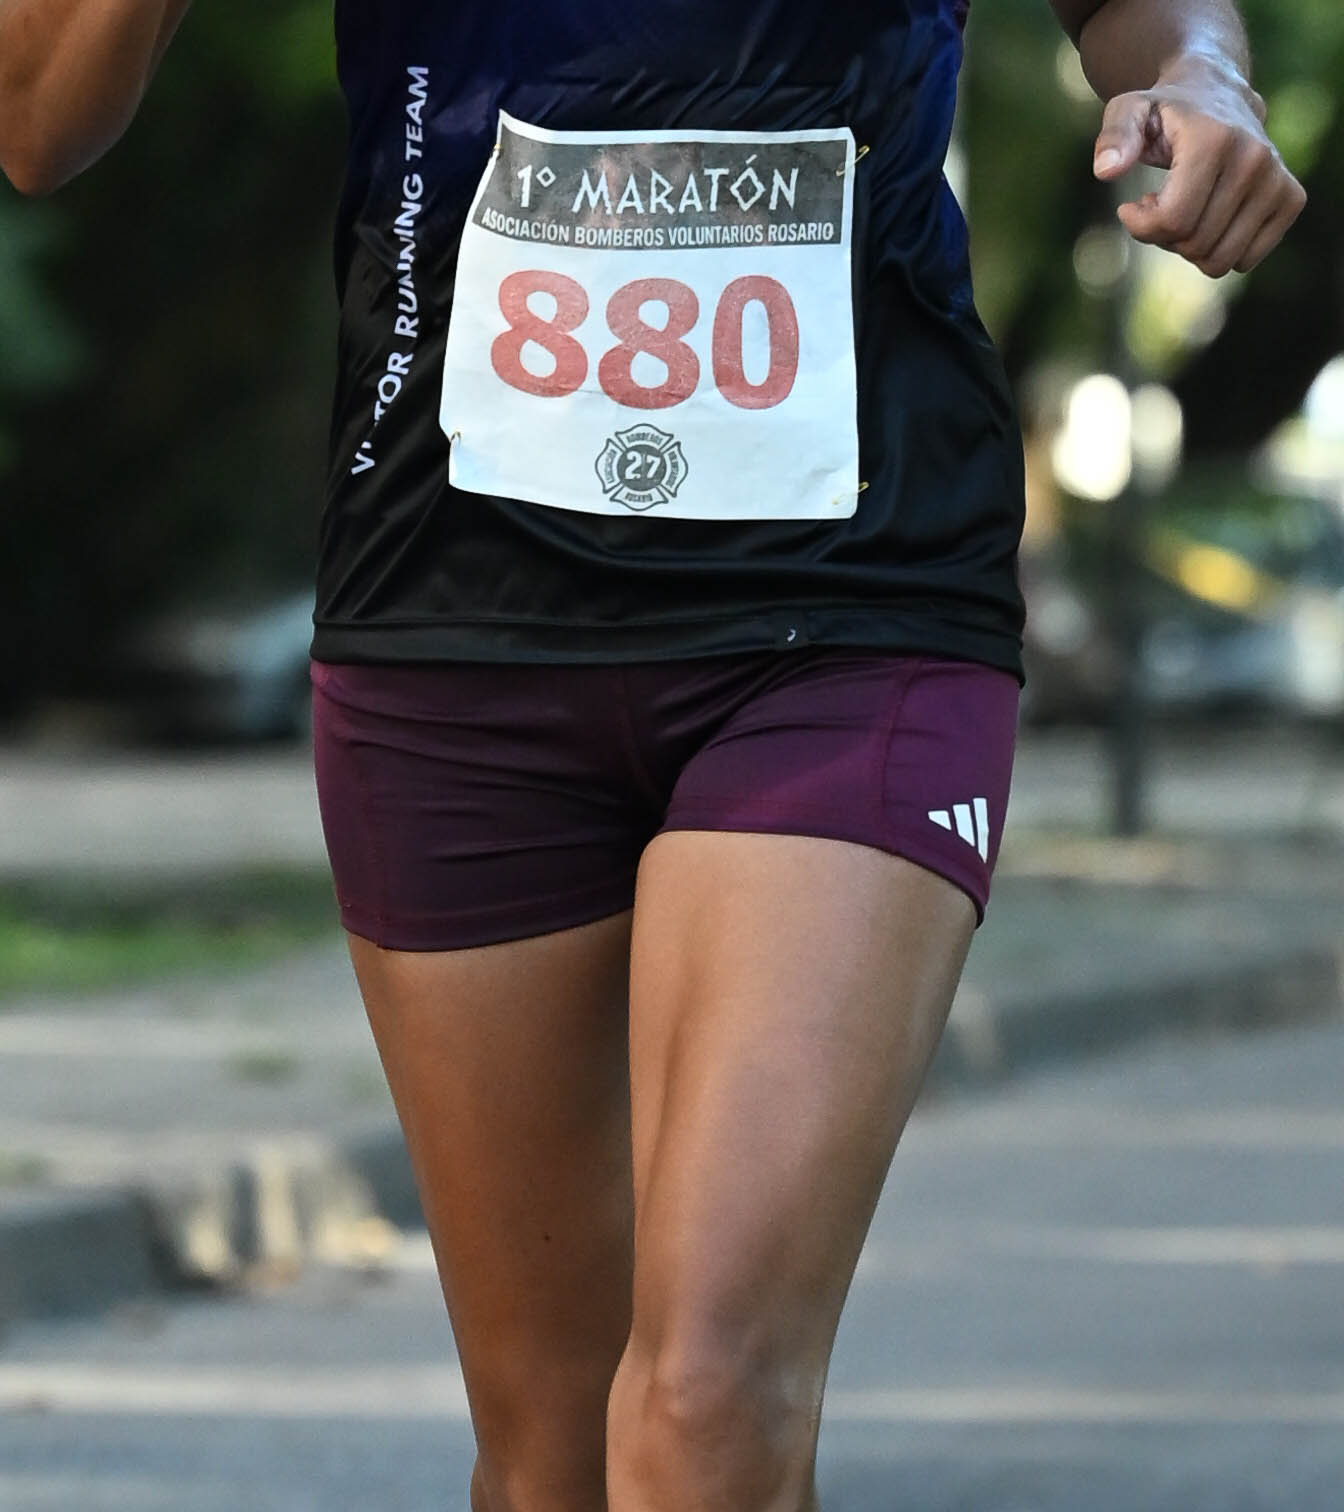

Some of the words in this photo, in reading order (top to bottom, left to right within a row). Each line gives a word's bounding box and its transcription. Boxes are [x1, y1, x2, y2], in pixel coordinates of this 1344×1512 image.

[404, 65, 430, 160] TEAM
[572, 154, 799, 216] MARATÓN
[482, 207, 569, 243] ASOCIACIÓN
[575, 226, 664, 246] BOMBEROS
[669, 223, 763, 245] VOLUNTARIOS
[768, 221, 835, 242] ROSARIO
[491, 269, 799, 411] 880
[625, 451, 661, 480] 27
